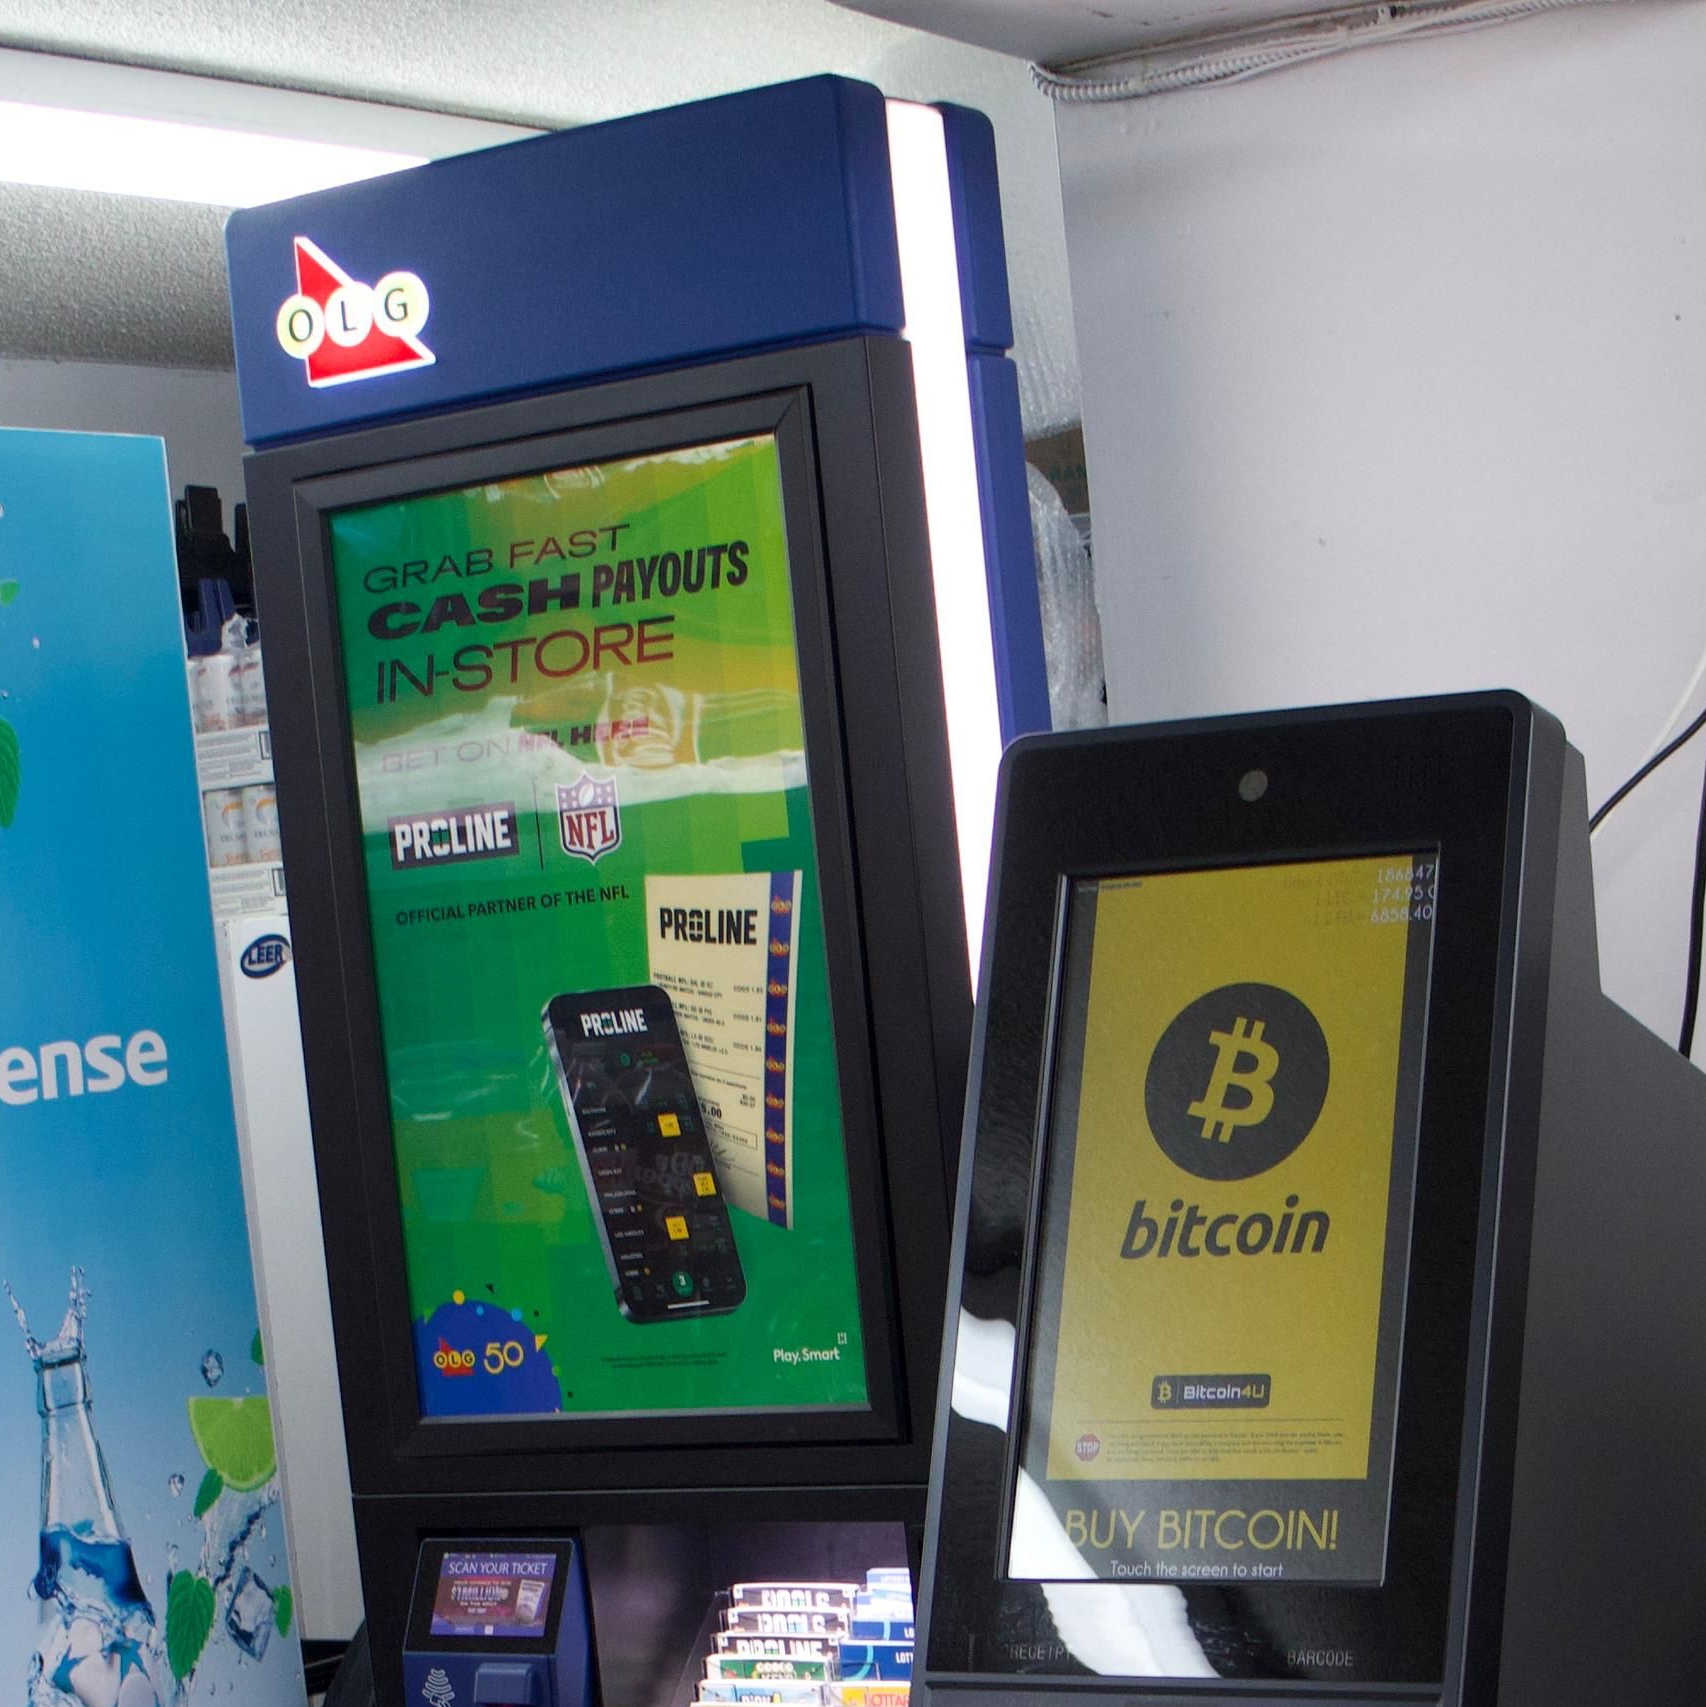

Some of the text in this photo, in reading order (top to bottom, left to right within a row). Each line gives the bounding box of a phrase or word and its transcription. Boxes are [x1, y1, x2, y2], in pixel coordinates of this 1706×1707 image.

[287, 288, 410, 343] OLG
[364, 524, 630, 593] GRAB FAST
[368, 541, 750, 640] CASH PAYOUTS
[378, 615, 675, 704] IN-STORE
[383, 746, 444, 774] BET
[457, 736, 511, 766] ON
[571, 717, 649, 746] HERE
[395, 810, 511, 862] PROLINE
[565, 807, 615, 848] NFL
[396, 886, 630, 926] OFFICIAL PARTNER OF THE NFL
[660, 907, 758, 945] PROLINE
[248, 943, 284, 966] LEER
[580, 1009, 648, 1037] PROLINE
[1120, 1194, 1331, 1260] bitcoin
[434, 1341, 524, 1374] OLG 50
[1183, 1382, 1265, 1400] Bitcoin4U
[1076, 1442, 1100, 1454] STOP
[1065, 1509, 1339, 1551] BUY BITCOIN!
[448, 1562, 548, 1575] SCAN YOUR TICKET
[1110, 1560, 1284, 1578] Touch the screen to start
[1287, 1650, 1354, 1668] BARCODE
